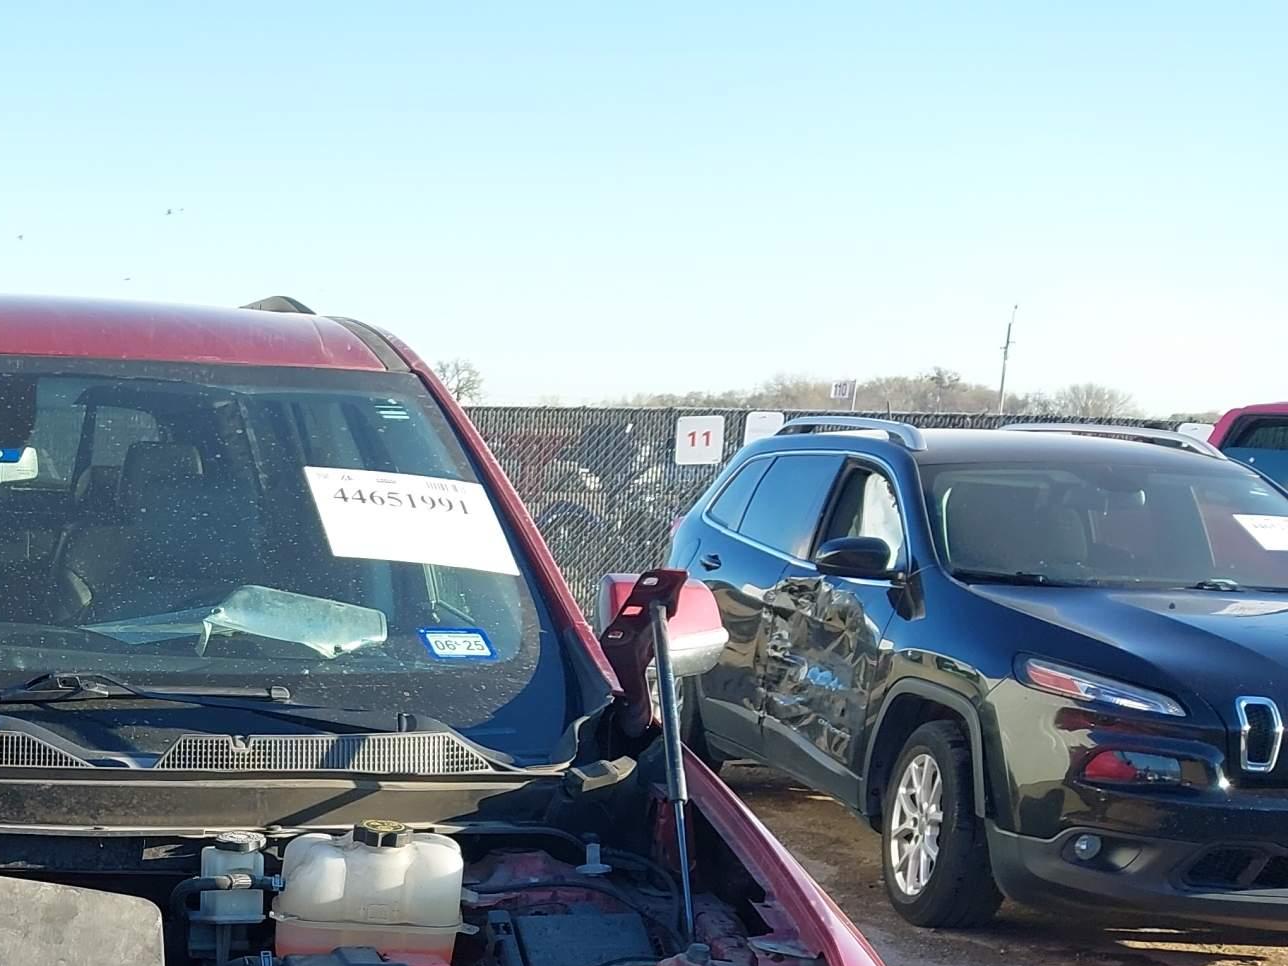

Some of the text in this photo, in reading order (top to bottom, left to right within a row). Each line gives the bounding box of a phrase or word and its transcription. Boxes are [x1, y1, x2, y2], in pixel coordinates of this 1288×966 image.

[687, 430, 712, 448] 11
[333, 487, 469, 515] 44651991
[462, 640, 486, 652] 25
